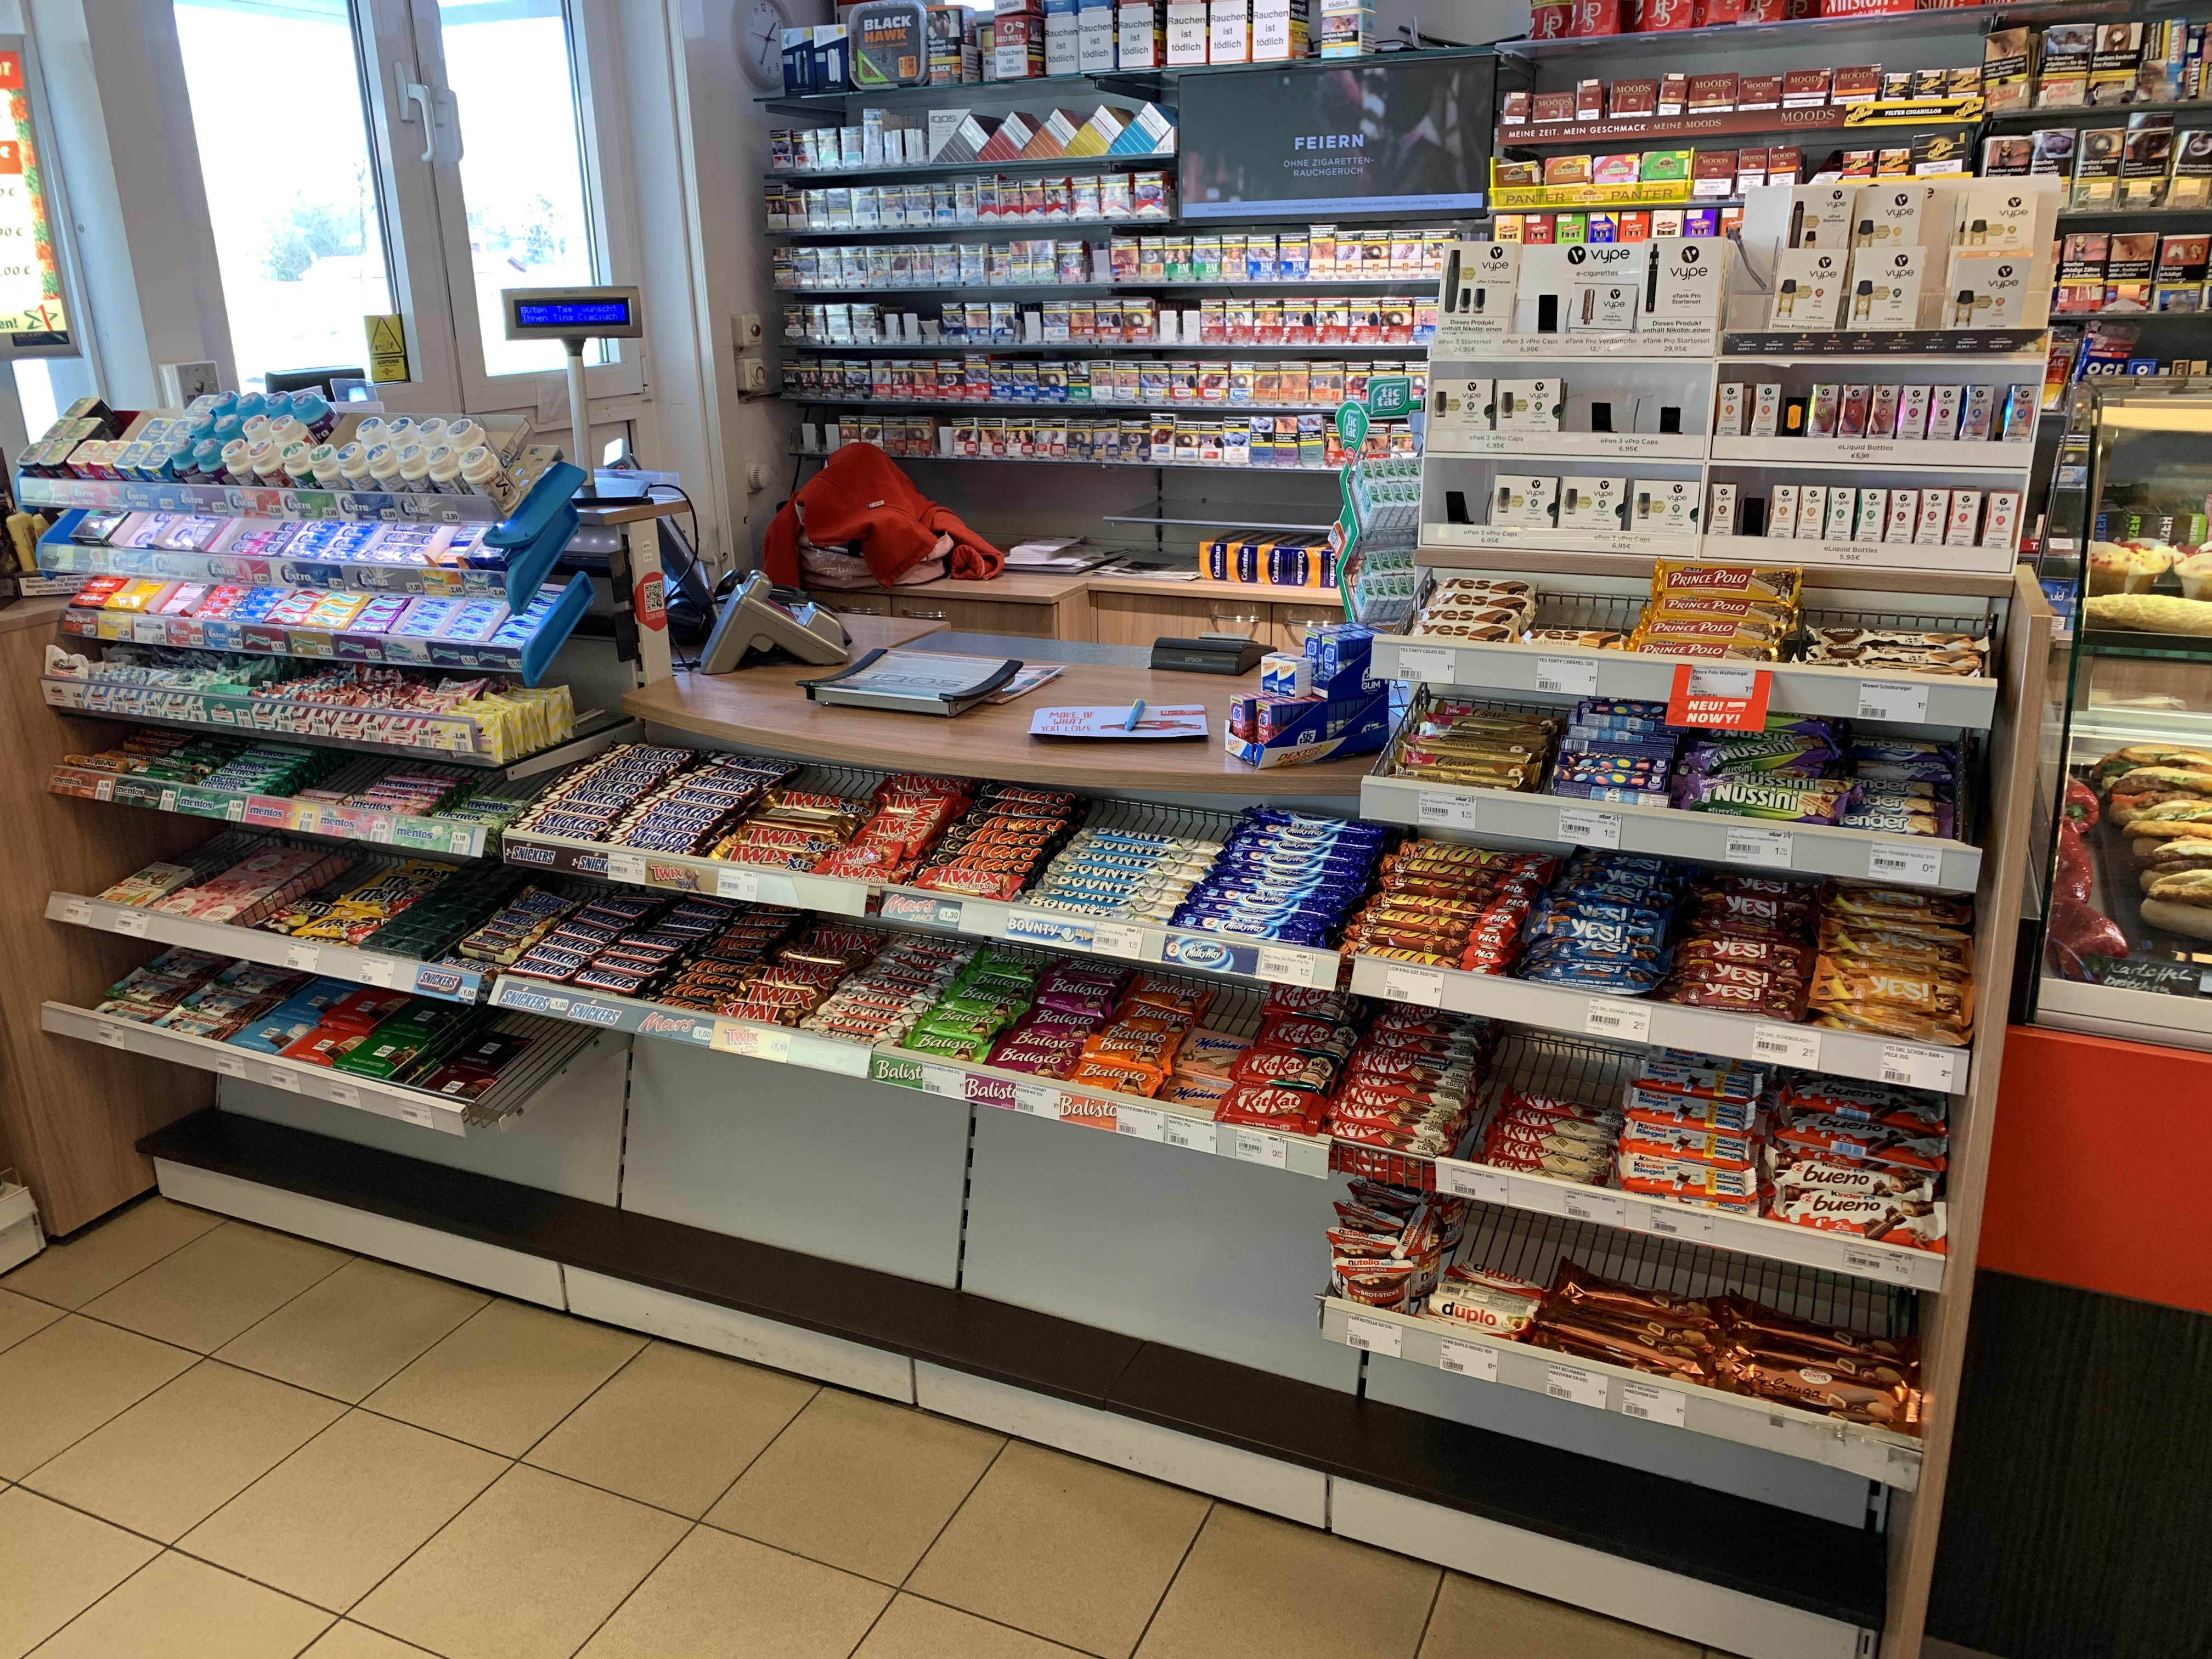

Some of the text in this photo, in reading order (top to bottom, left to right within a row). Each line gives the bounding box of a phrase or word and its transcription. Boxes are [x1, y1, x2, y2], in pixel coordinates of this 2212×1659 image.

[1168, 16, 1205, 25] Rauchen
[1254, 10, 1288, 19] Rauchen
[864, 15, 911, 32] BLACK
[1119, 19, 1153, 30] Rauchen
[1266, 24, 1276, 32] ist
[864, 29, 906, 42] HAWK
[1131, 33, 1140, 42] ist
[1182, 30, 1192, 38] ist
[1172, 42, 1201, 52] tödlich
[1256, 37, 1283, 46] tödlich
[1122, 43, 1148, 55] tödlich
[2189, 57, 2201, 96] DRUM
[1695, 78, 1731, 89] MOODS
[1780, 110, 1835, 122] MOODS
[1508, 130, 1535, 138] MEINE
[1563, 126, 1585, 134] MEIN
[1590, 123, 1649, 134] GESCHMACK.
[1653, 121, 1682, 130] MEINE
[1686, 119, 1722, 128] MOODS
[1294, 134, 1364, 150] FEIERN
[1283, 157, 1374, 167] OHNE ZIGARETTEN-
[1293, 167, 1363, 177] RAUCHGERUCH
[1506, 193, 1565, 205] PANTER
[1592, 249, 1630, 263] vype
[1482, 261, 1508, 271] vype
[1670, 266, 1708, 280] vype
[1381, 388, 1399, 397] tic
[1377, 396, 1400, 408] tac
[1671, 569, 1747, 585] PRINCE POLO
[1361, 681, 1380, 690] GUM
[1688, 700, 1724, 711] NEU!
[1686, 713, 1739, 724] NOWY!
[1277, 744, 1322, 761] DEXTRO
[54, 777, 81, 787] mentos
[320, 816, 354, 828] mentos
[396, 827, 433, 839] mentos
[511, 847, 555, 864] SNICKERS
[881, 894, 936, 915] Mars
[909, 913, 934, 922] 2PACK
[1008, 918, 1058, 935] BOUNTY
[1478, 934, 1499, 944] PACK
[1713, 940, 1766, 958] YES!
[420, 972, 457, 988] SNICKERS
[1870, 975, 1928, 1000] YES!
[501, 991, 549, 1010] SNICKERS
[1312, 1060, 1330, 1073] WIN
[1060, 1096, 1117, 1118] Balisto
[1245, 1093, 1300, 1113] KitKat
[1831, 1190, 1861, 1199] kinder
[1813, 1195, 1881, 1211] bueno
[1348, 1259, 1379, 1267] nutella
[1442, 1301, 1497, 1327] duplo
